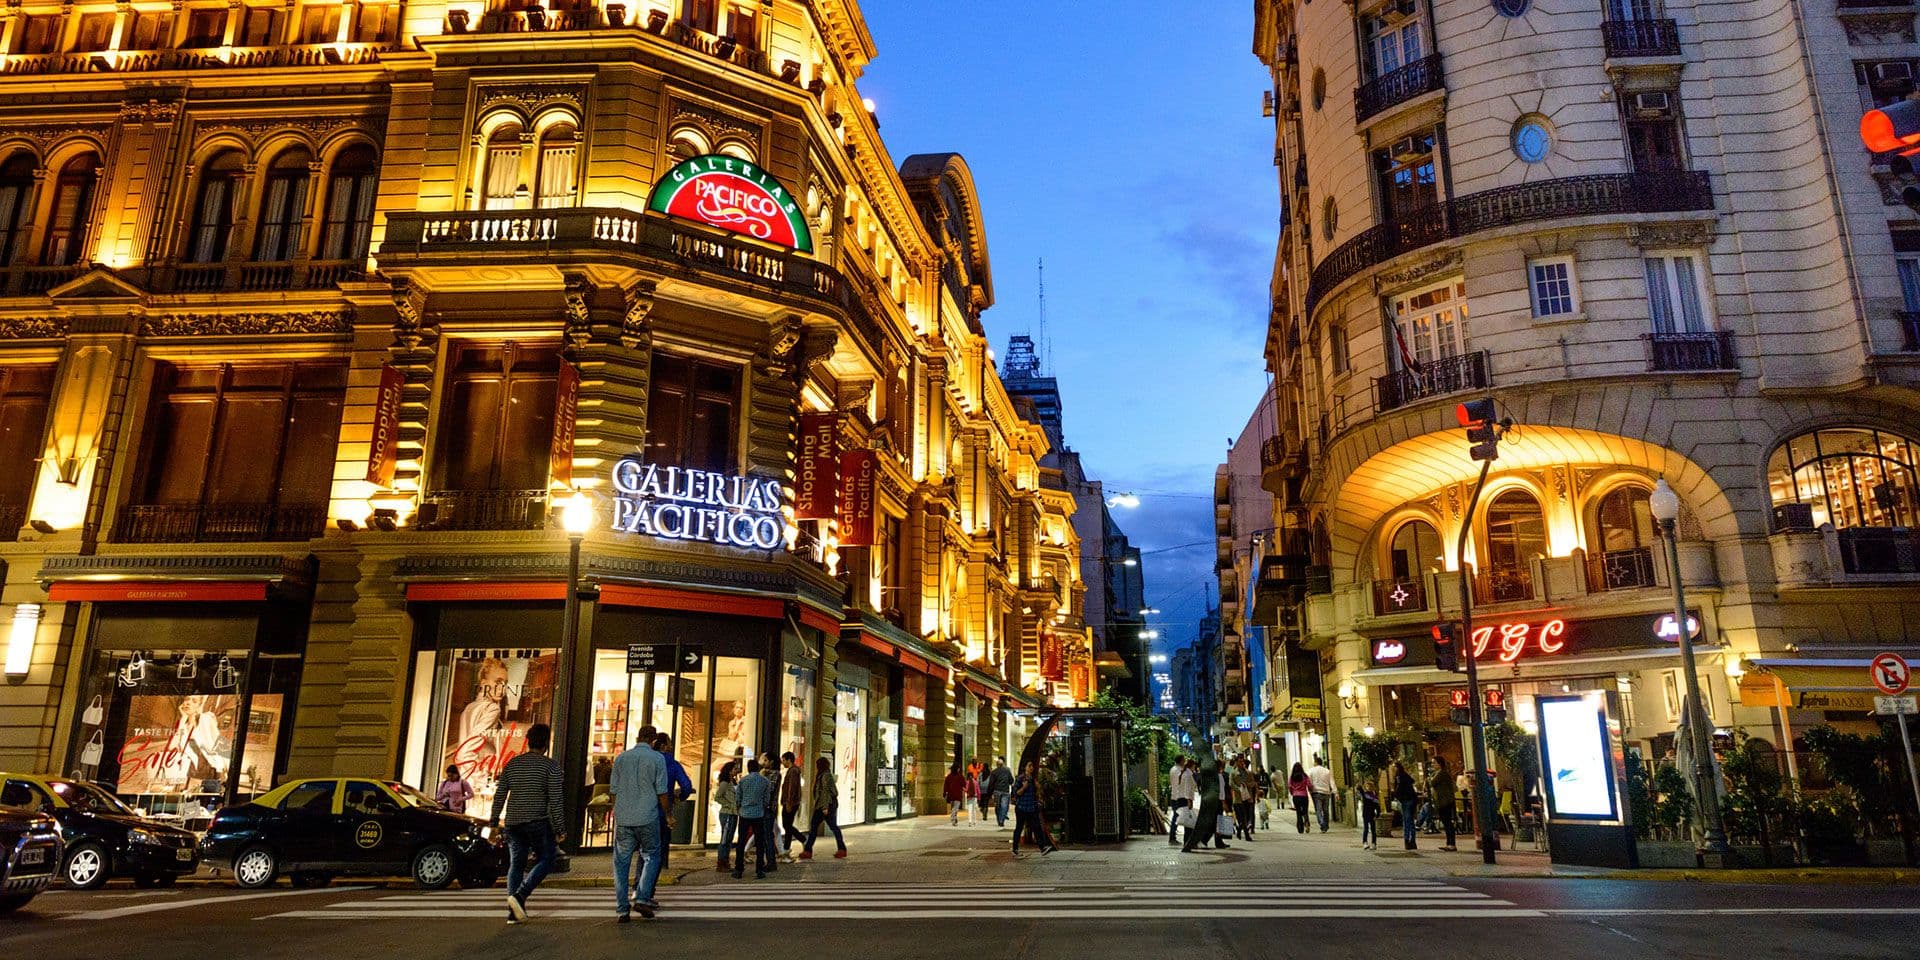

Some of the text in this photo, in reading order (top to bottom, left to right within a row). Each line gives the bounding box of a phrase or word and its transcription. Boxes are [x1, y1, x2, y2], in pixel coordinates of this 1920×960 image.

[672, 159, 796, 213] GALERIAS
[695, 178, 777, 217] PACIFICO
[391, 382, 400, 420] Mall
[562, 381, 577, 453] Pacifico
[370, 388, 392, 472] Shopping
[552, 394, 566, 468] Galerias
[818, 425, 832, 458] Mall
[611, 458, 782, 513] GALERIAS
[800, 435, 817, 510] Shopping
[858, 459, 871, 518] Pacifico
[611, 497, 780, 549] PACIFICO
[841, 476, 855, 537] Galerias
[134, 728, 161, 737] TASTE
[1236, 719, 1251, 729] citi
[117, 719, 195, 785] Sale!
